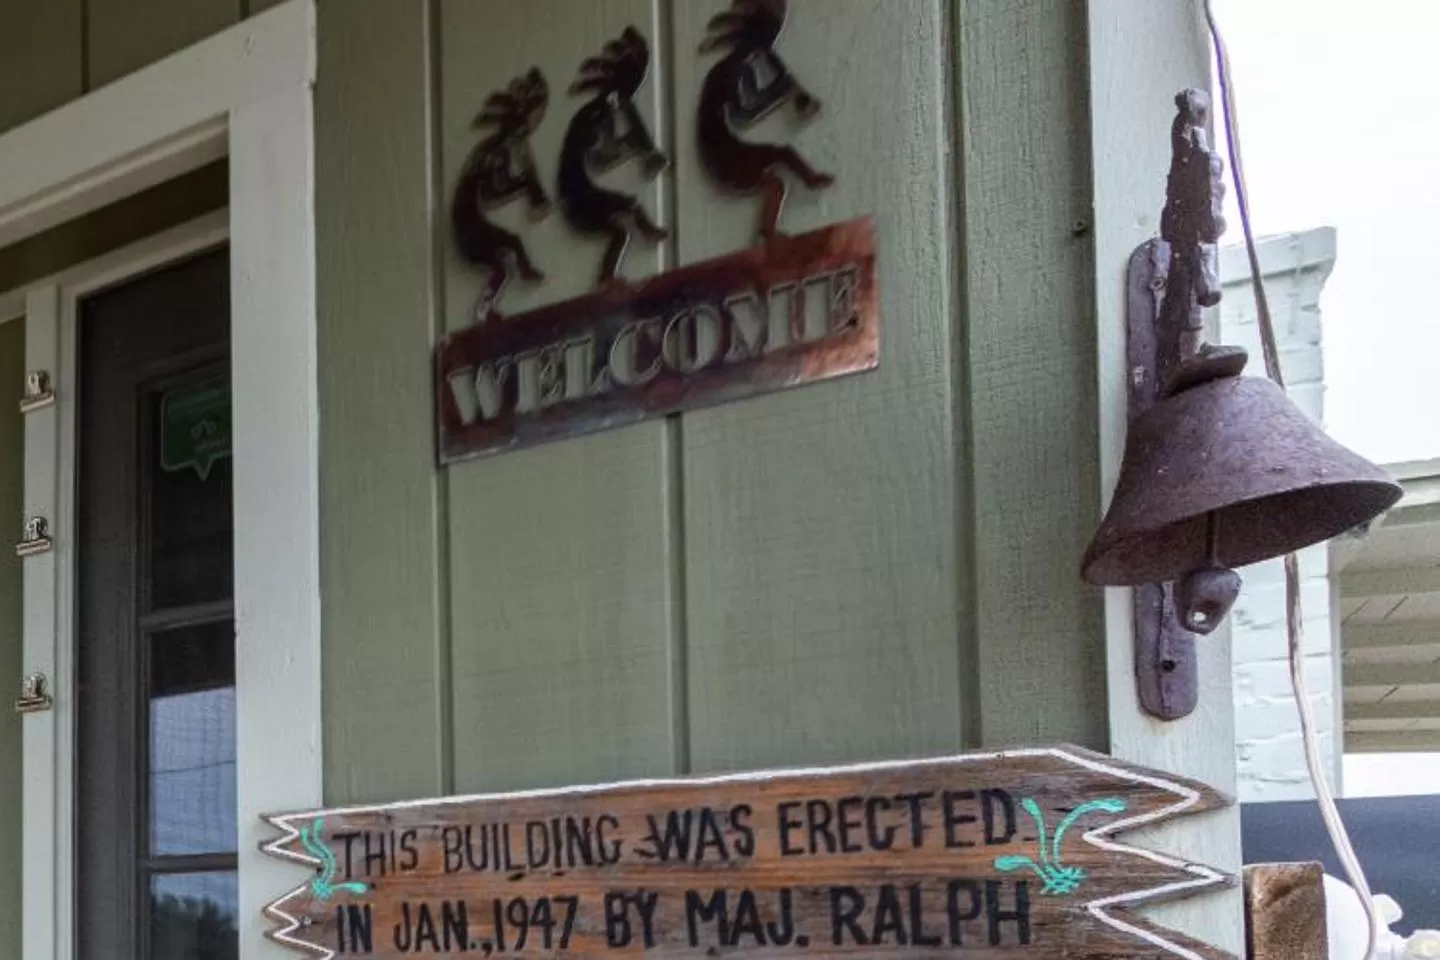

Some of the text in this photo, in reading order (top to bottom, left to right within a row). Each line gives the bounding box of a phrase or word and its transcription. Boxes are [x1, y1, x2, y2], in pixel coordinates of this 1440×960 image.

[446, 266, 859, 427] WELCOME
[333, 788, 1017, 880] THIS BUILDING WAS ERECTED
[336, 903, 373, 954] IN
[603, 888, 659, 949] BY
[685, 887, 811, 948] MAJ.
[829, 879, 1031, 946] RALPH
